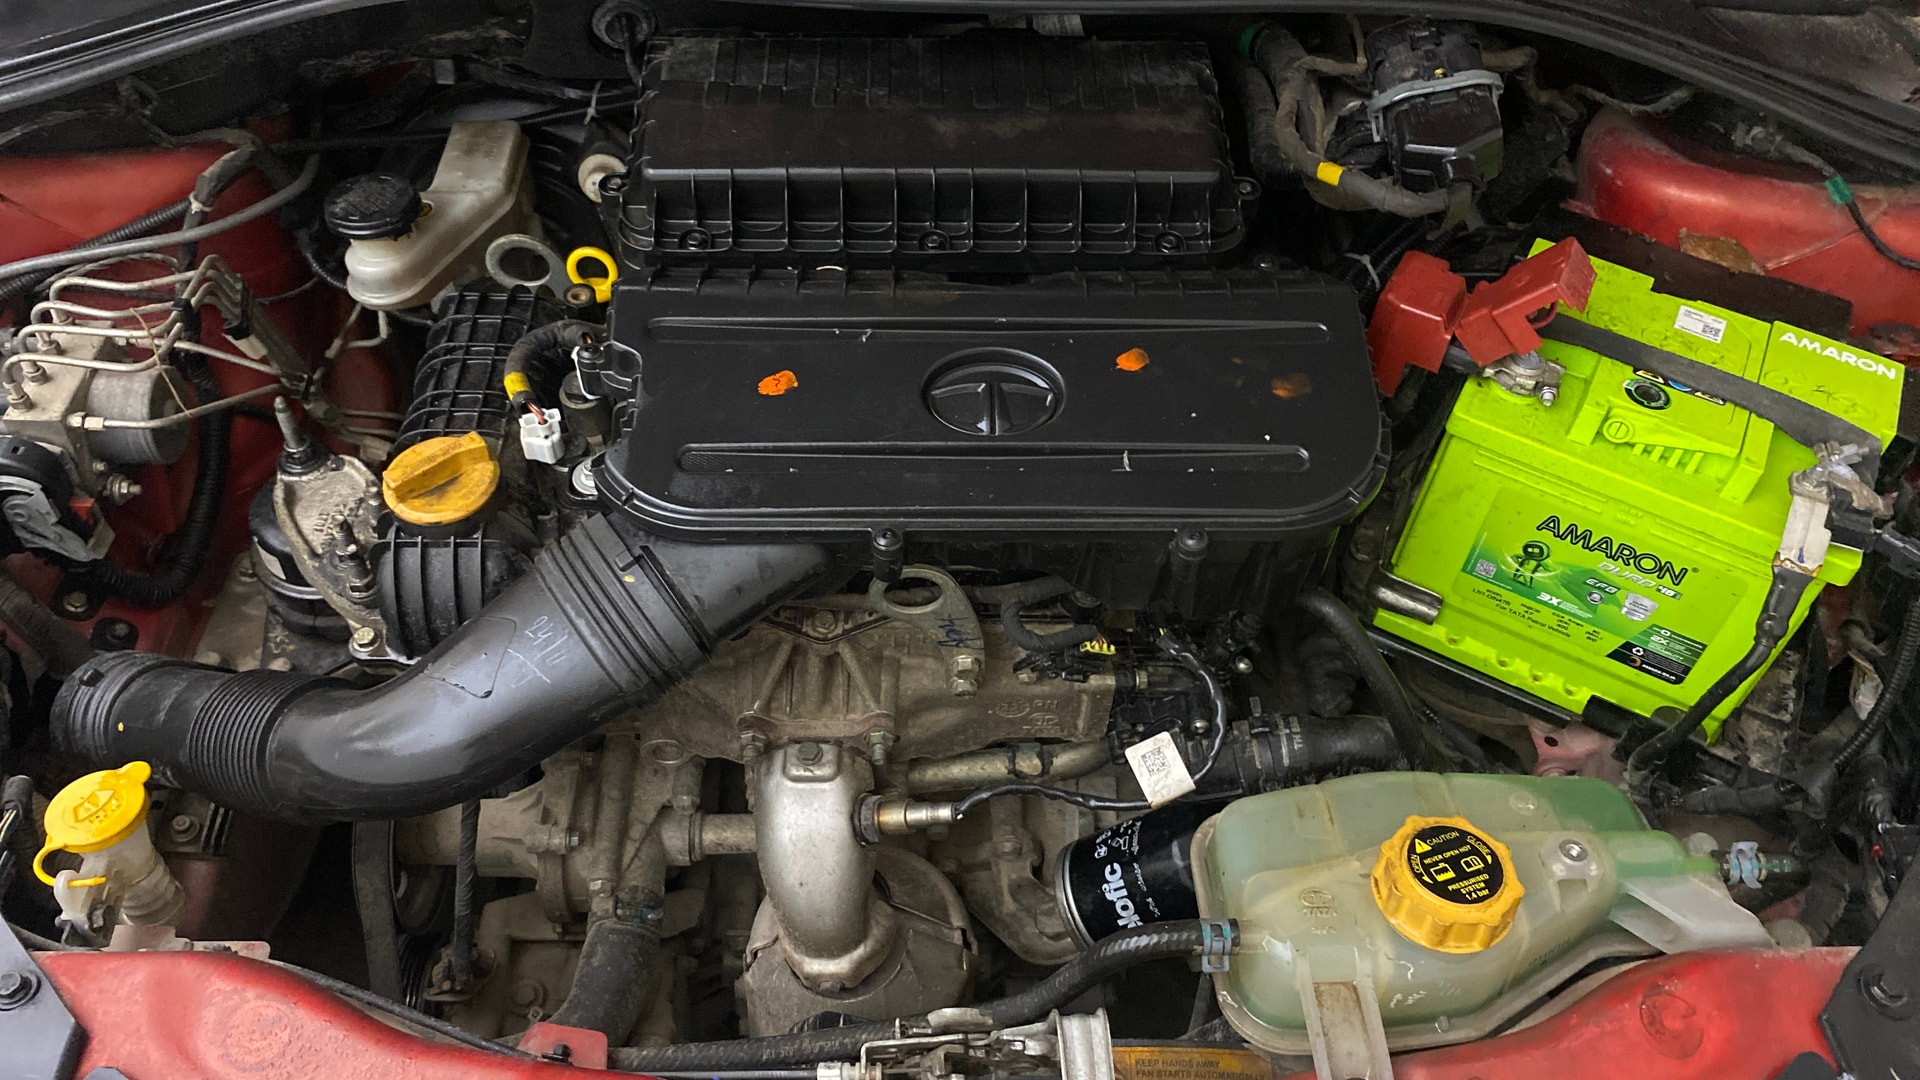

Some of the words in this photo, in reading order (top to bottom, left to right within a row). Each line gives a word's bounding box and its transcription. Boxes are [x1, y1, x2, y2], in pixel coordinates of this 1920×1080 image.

[1779, 332, 1896, 380] AMARON
[1536, 515, 1688, 586] AMARON
[1597, 561, 1657, 589] DURO
[1508, 607, 1526, 619] TATA
[1426, 830, 1460, 846] CAUTION
[1466, 835, 1491, 855] CLOSE
[1410, 853, 1421, 873] OPEN
[1423, 854, 1444, 865] NEVER
[1442, 848, 1460, 858] OPEN
[1459, 844, 1472, 853] HOT
[1447, 873, 1490, 892] PRESSURISED
[1460, 882, 1486, 895] SYSTEM
[1477, 888, 1490, 898] bar
[1135, 1058, 1160, 1067] KEEP
[1162, 1059, 1194, 1068] HANDS
[1196, 1060, 1220, 1069] AWAY
[1136, 1069, 1154, 1078] FAN
[1156, 1070, 1192, 1079] STARTS
